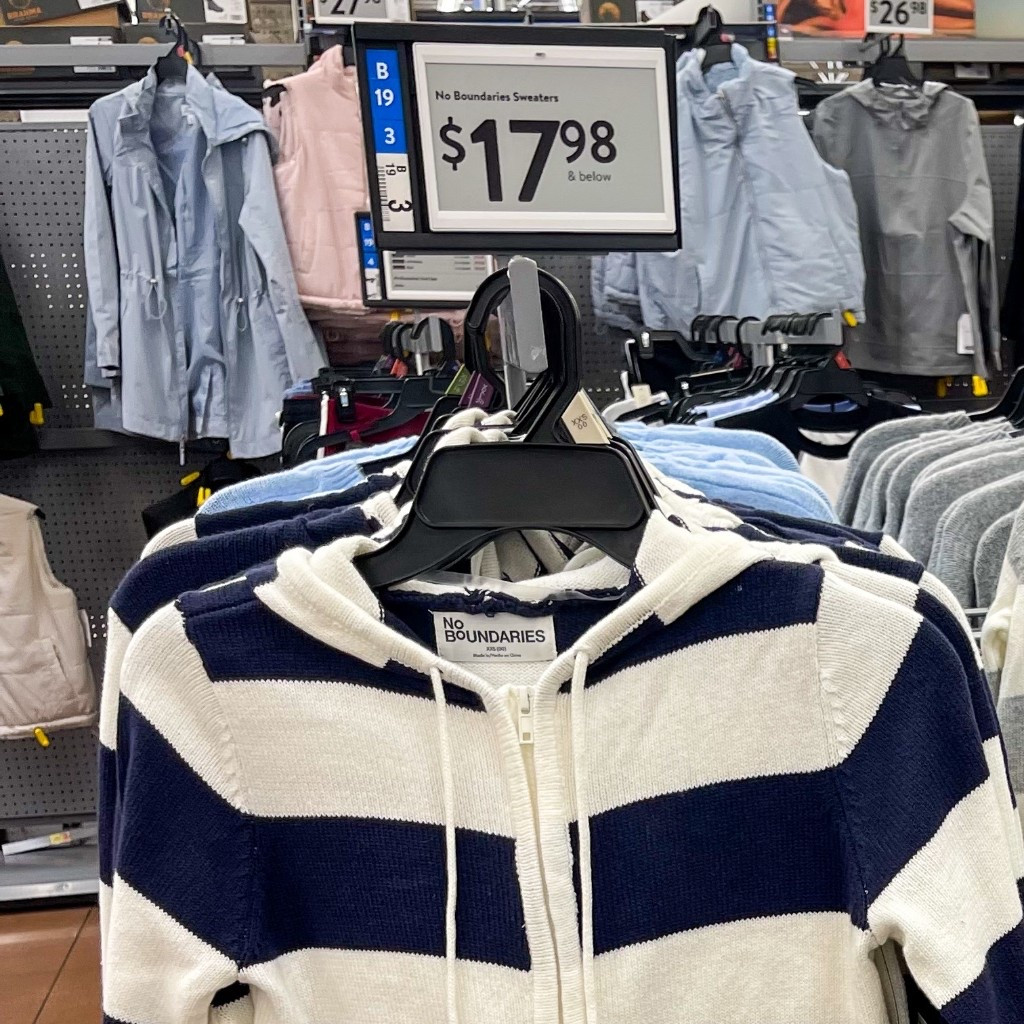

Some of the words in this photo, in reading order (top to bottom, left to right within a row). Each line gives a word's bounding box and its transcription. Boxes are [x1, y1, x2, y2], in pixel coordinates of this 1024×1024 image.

[376, 62, 390, 80] B
[374, 88, 394, 107] 19
[435, 90, 451, 101] No
[453, 91, 511, 102] Boundaries
[513, 92, 559, 103] Sweaters
[384, 127, 396, 145] 3
[568, 171, 577, 181] &
[579, 170, 612, 182] below
[571, 413, 588, 426] XXS
[443, 617, 464, 630] No
